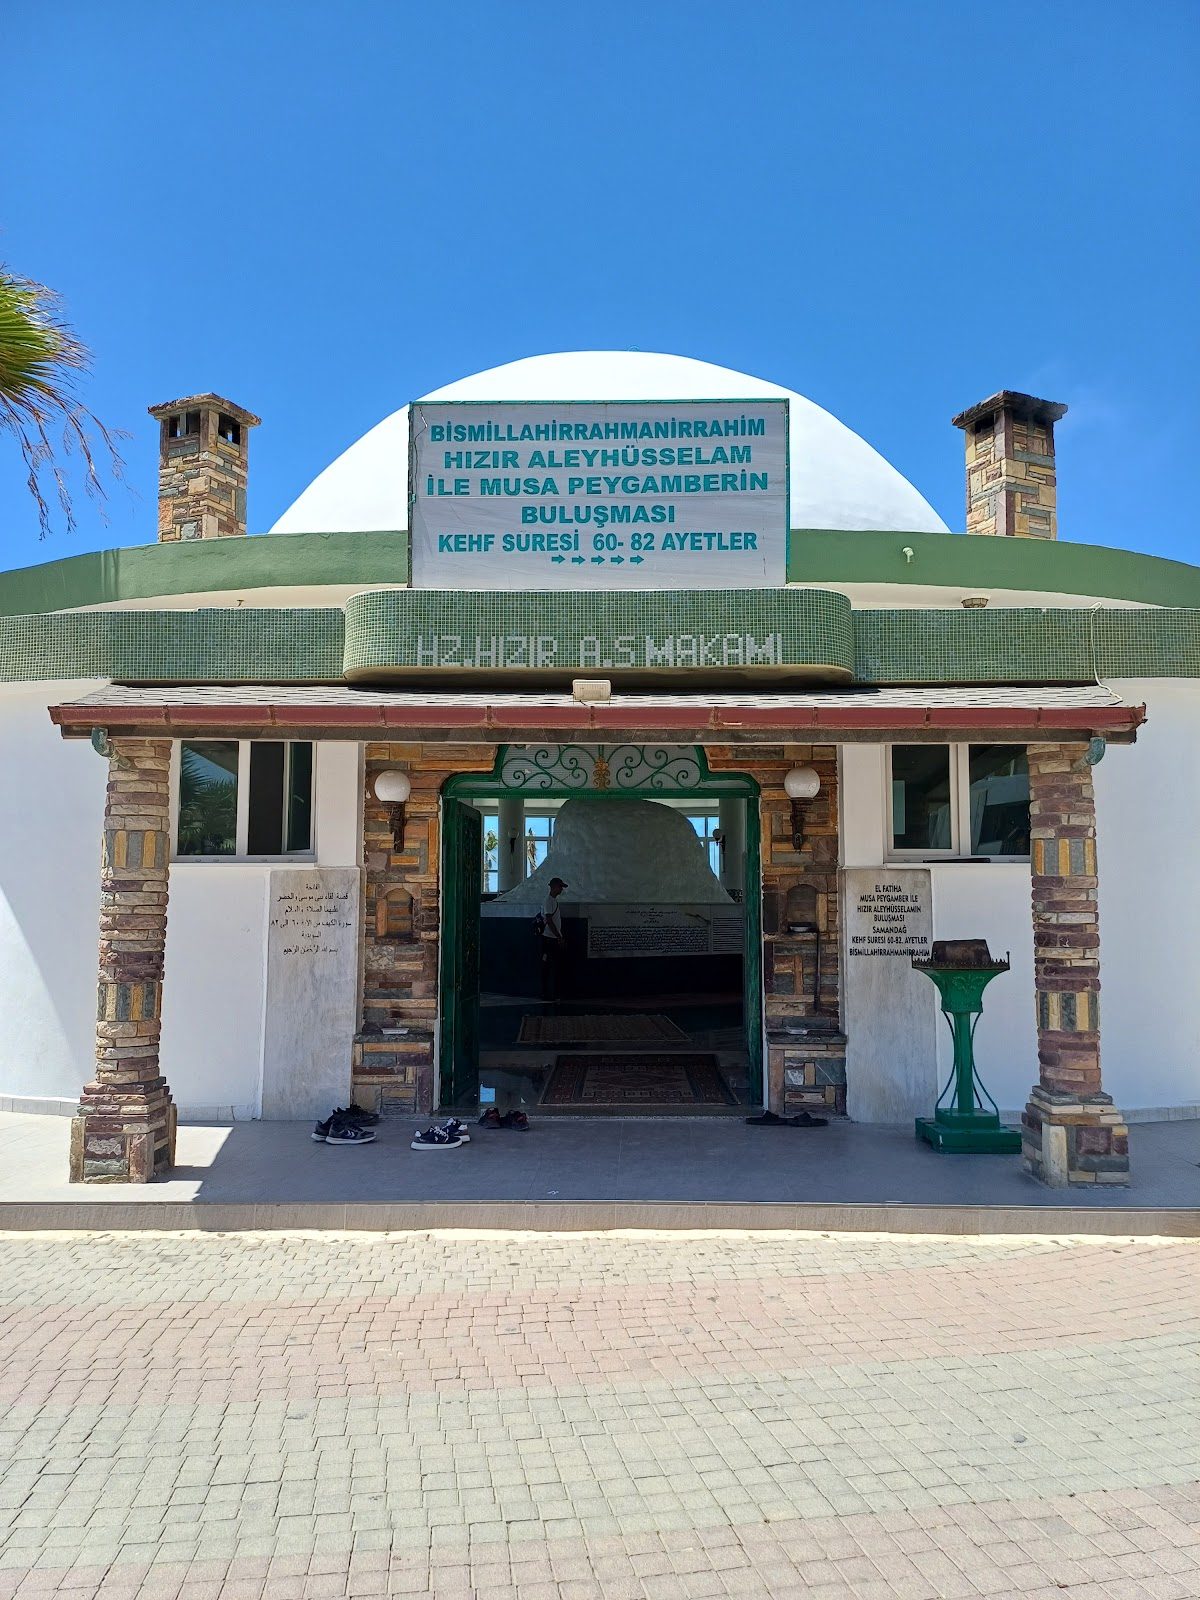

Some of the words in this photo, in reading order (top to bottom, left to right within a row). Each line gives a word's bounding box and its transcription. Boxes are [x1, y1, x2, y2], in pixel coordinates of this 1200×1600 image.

[430, 415, 766, 442] BİSMİLLAHİRRAHMANİRRAHİM
[444, 450, 520, 469] HIZIR
[528, 445, 752, 469] ALEYHÜSSELAM
[427, 474, 470, 496] İLE
[480, 477, 559, 496] MUSA
[568, 469, 768, 495] PEYGAMBERİN
[521, 505, 675, 528] BULUŞMASI
[438, 534, 495, 552] KEHF
[662, 532, 757, 551] AYETLER
[580, 635, 635, 668] A.S
[646, 632, 782, 666] MAKAMI
[875, 885, 882, 893] EL
[882, 883, 902, 893] FATİHA
[860, 894, 876, 903] MUSA
[876, 894, 909, 903] PEYGAMBER
[910, 893, 918, 903] İLE
[857, 905, 872, 913] HIZIR
[873, 903, 921, 913] ALEYHÜSSELAMIN
[874, 914, 905, 924] BULUŞMASI
[872, 925, 907, 934] SAMANDAĞ
[852, 936, 866, 944] KEHF
[867, 935, 886, 944] SURESİ
[904, 936, 928, 944] AYETLER
